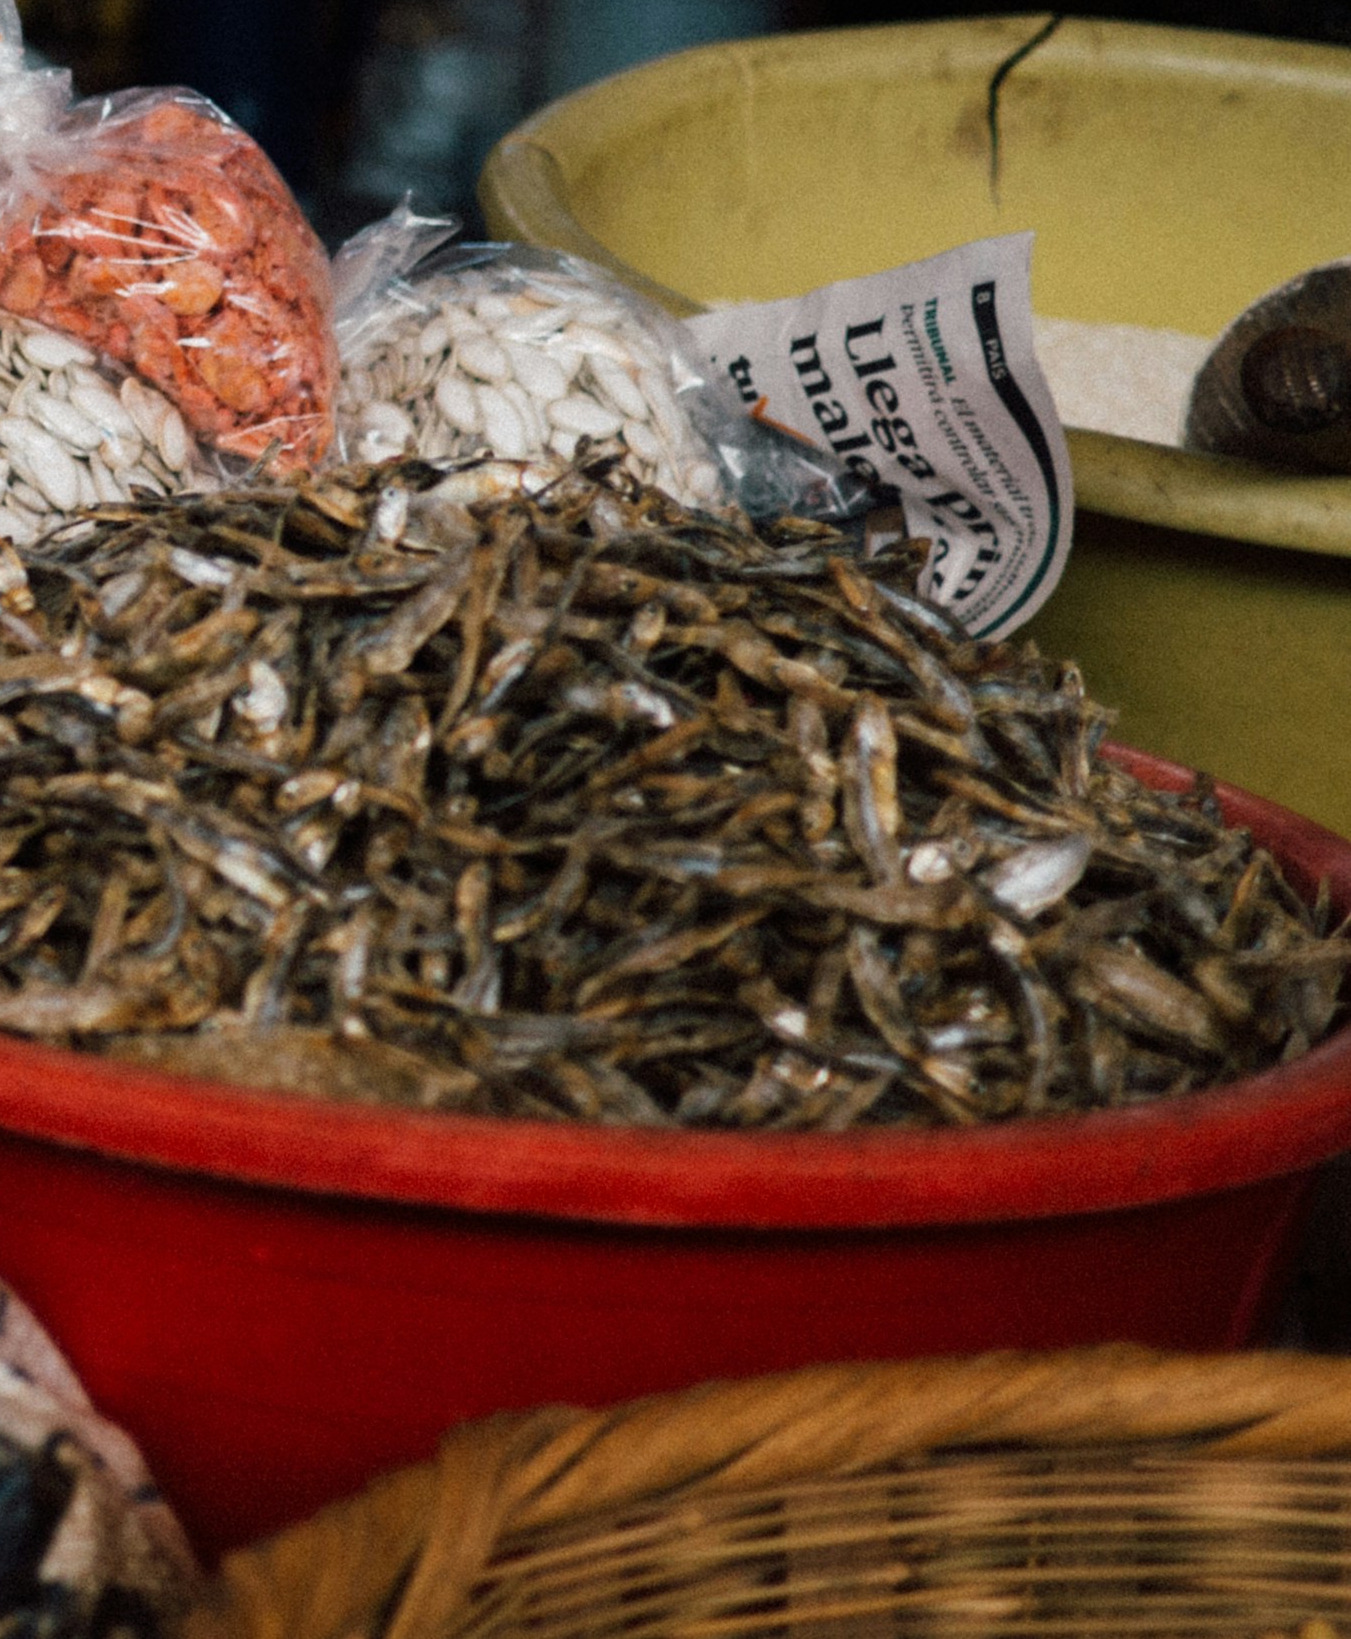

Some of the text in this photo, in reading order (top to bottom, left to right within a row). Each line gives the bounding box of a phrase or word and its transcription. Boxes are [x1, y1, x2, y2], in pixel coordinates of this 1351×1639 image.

[844, 313, 937, 480] Llega
[923, 297, 957, 386] TRIBUNAL
[950, 396, 976, 417] El
[964, 419, 1029, 504] material
[934, 409, 996, 497] controlar
